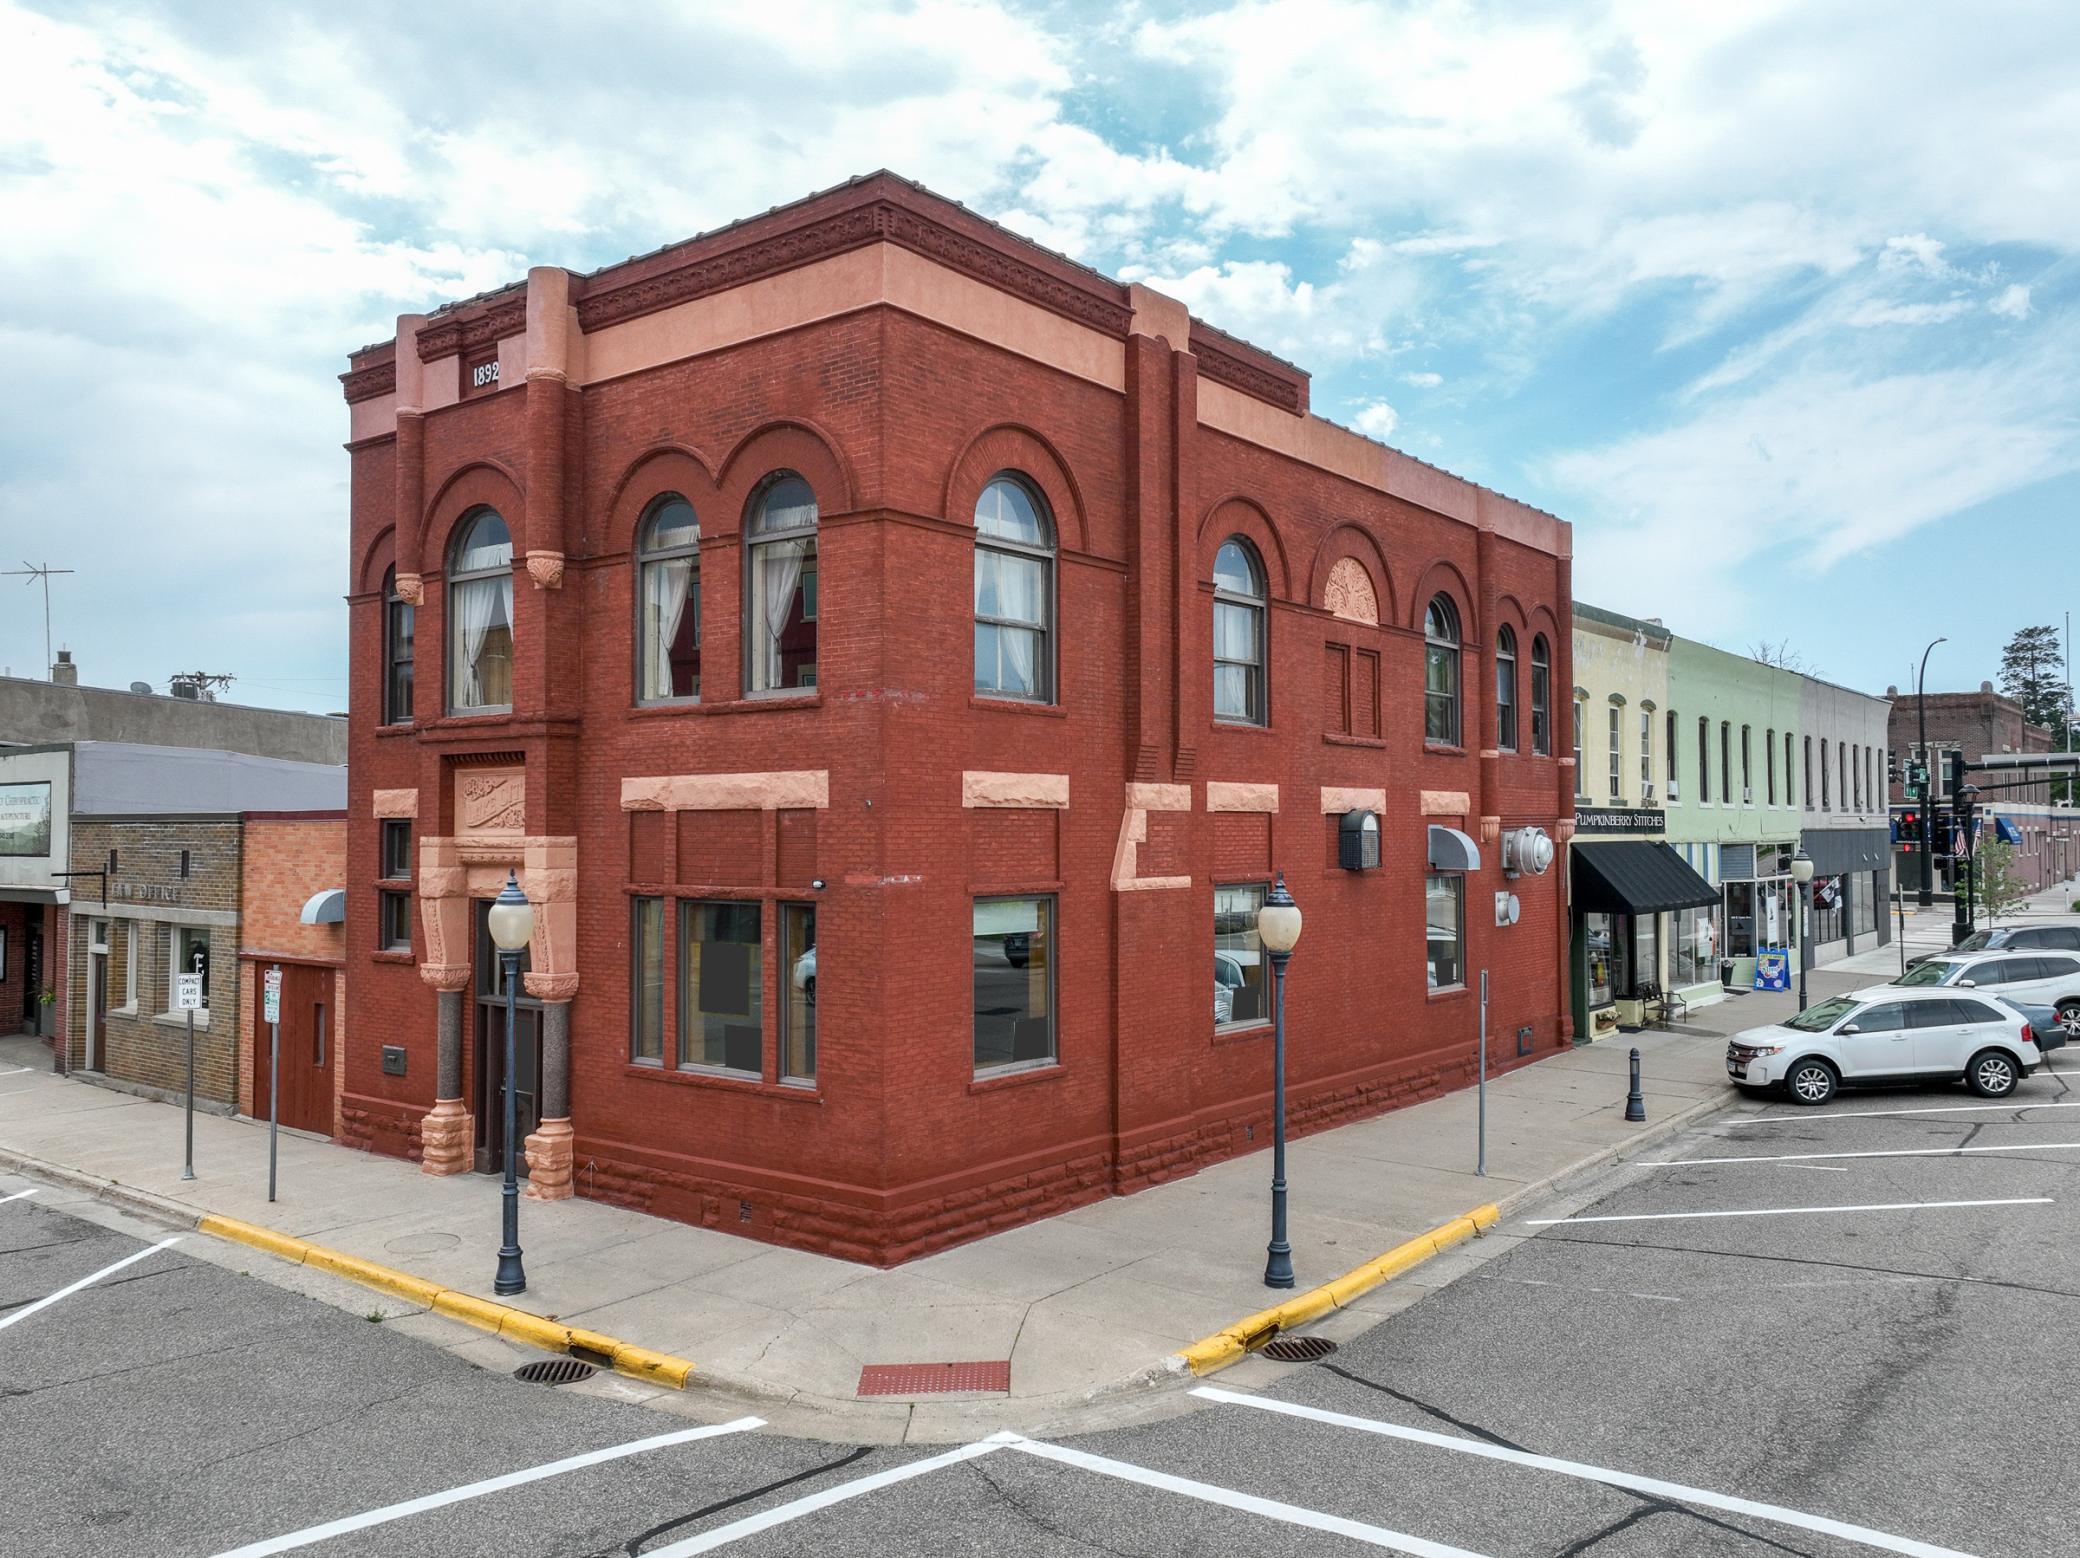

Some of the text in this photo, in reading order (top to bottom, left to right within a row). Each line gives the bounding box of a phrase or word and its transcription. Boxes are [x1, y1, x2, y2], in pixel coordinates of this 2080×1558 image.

[473, 361, 500, 387] 1892
[1575, 812, 1664, 827] PUMPKINBERRY STITCHES
[139, 883, 176, 900] OFFICE
[178, 977, 200, 986] COMPACT
[182, 988, 197, 996] CARS
[182, 998, 197, 1006] ONLY
